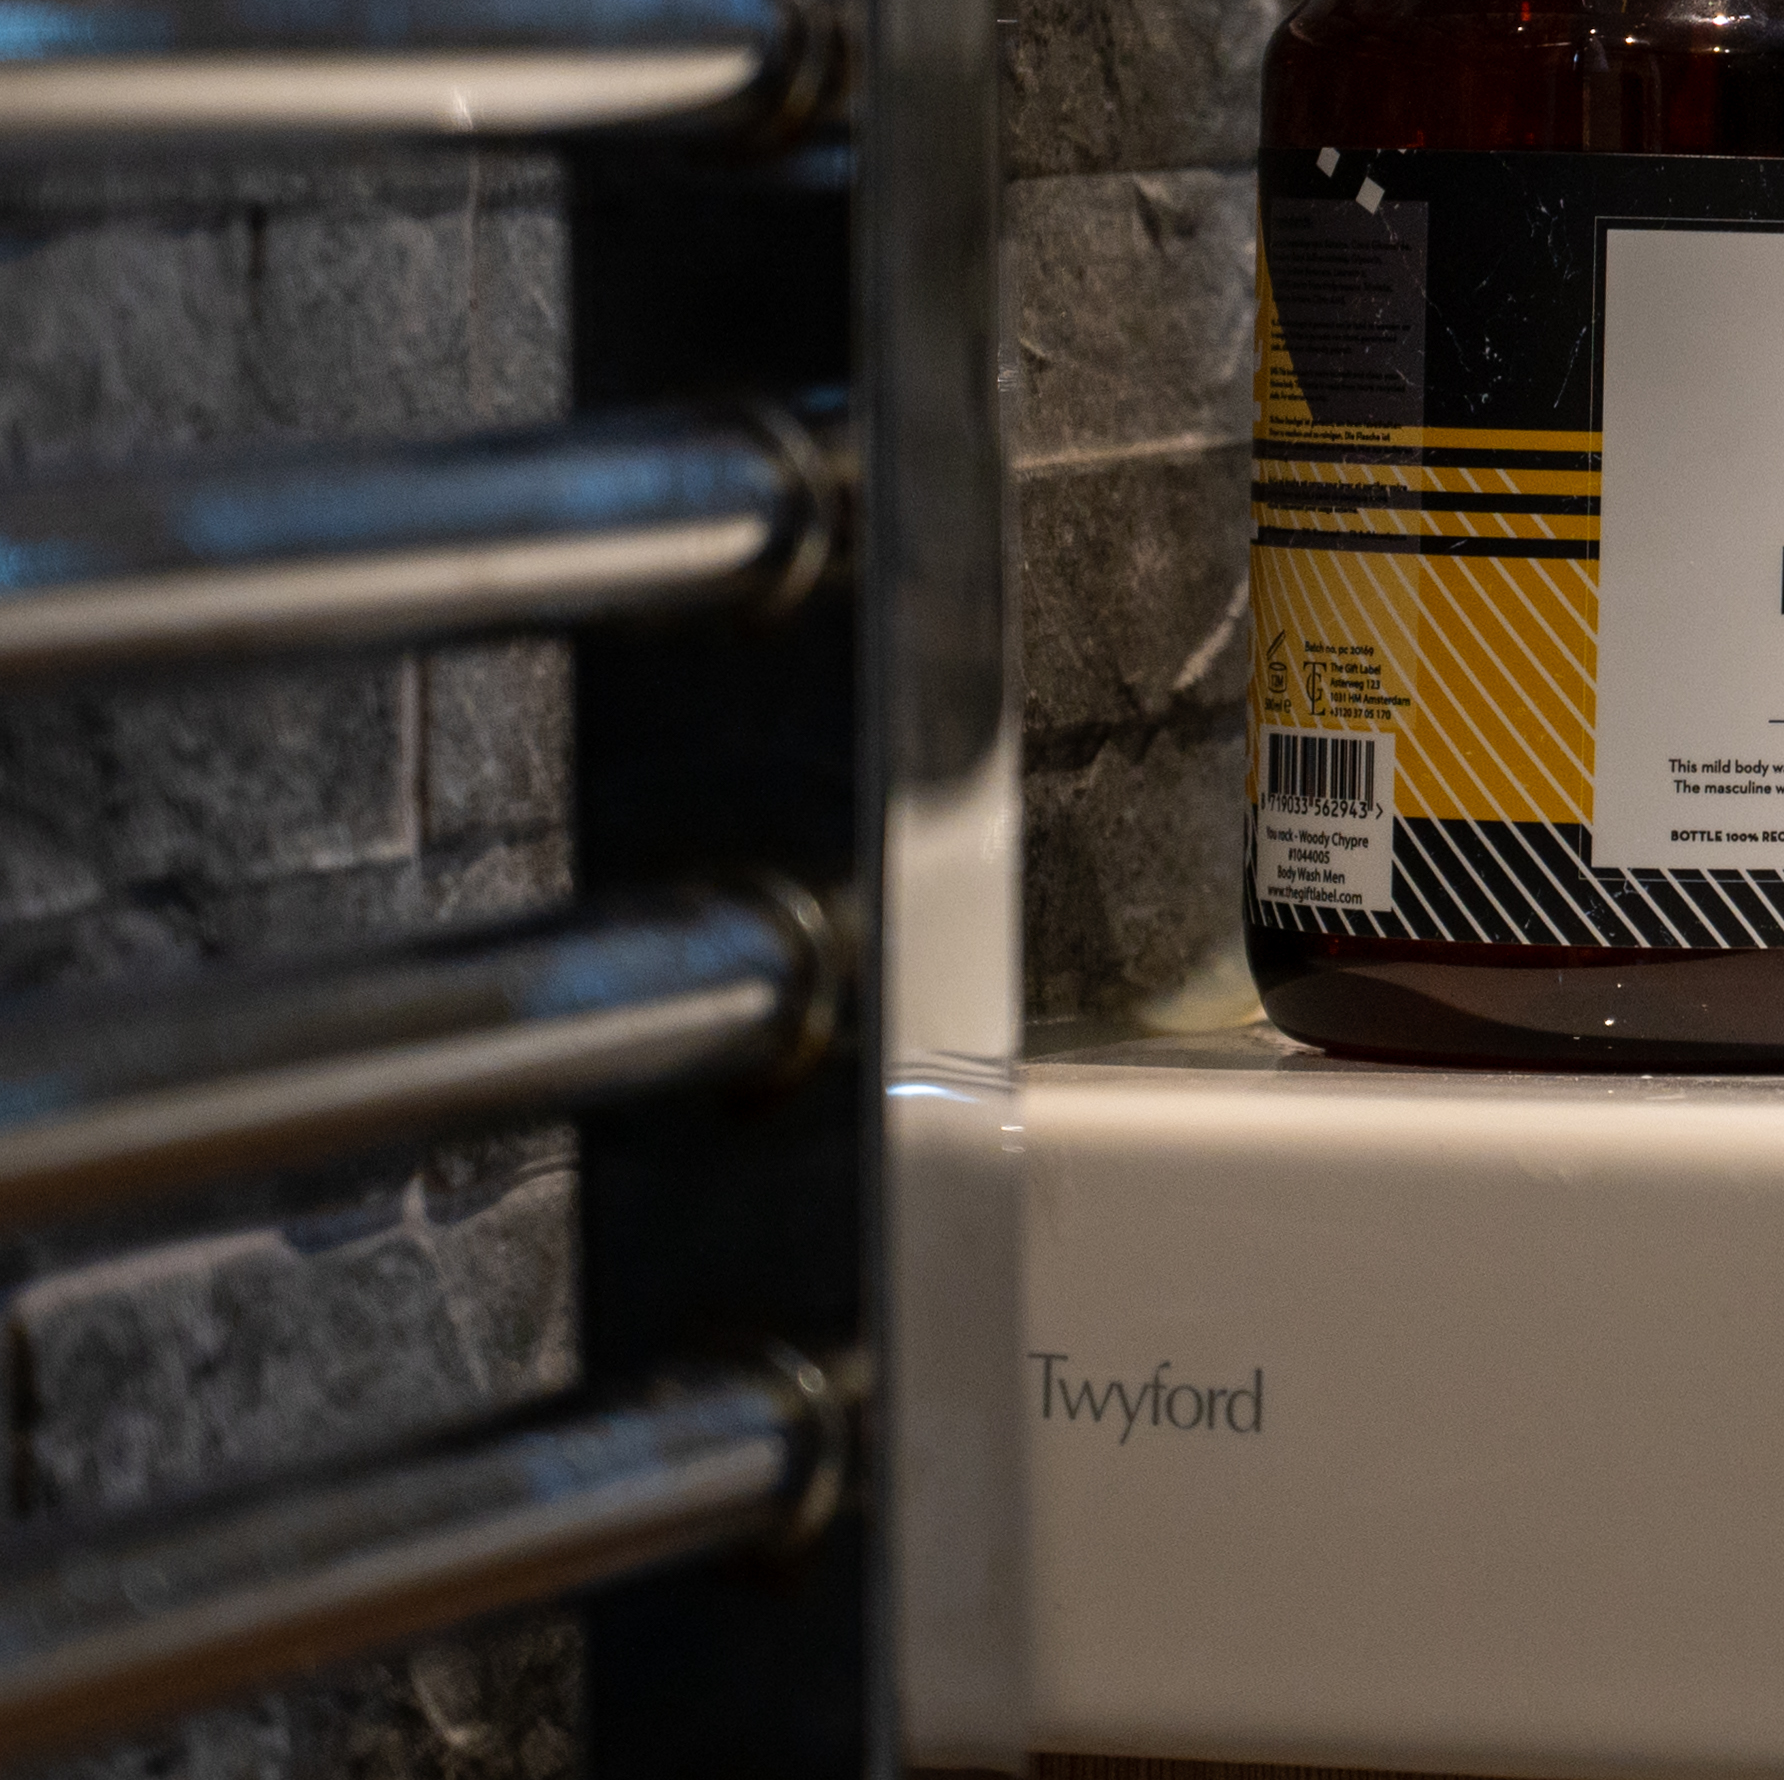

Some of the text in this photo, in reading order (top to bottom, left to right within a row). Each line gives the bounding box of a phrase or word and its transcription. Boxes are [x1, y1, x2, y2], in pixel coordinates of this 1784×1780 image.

[1305, 641, 1324, 653] Batch
[1331, 663, 1381, 675] The Gift Label
[1366, 679, 1380, 690] 123
[1330, 692, 1411, 707] 1031 HM Amsterdam
[1353, 707, 1363, 718] 37
[1376, 709, 1391, 720] 170
[1668, 759, 1698, 774] This
[1701, 759, 1732, 774] mild
[1735, 759, 1769, 777] body
[1673, 779, 1701, 794] The
[1704, 779, 1772, 795] masculine
[1269, 794, 1308, 815] 719033
[1314, 799, 1368, 819] 562943
[1266, 826, 1277, 840] You
[1278, 828, 1293, 842] rock
[1299, 830, 1330, 848] Woody
[1331, 832, 1369, 850] Chypre
[1671, 830, 1723, 842] BOTTLE
[1726, 831, 1759, 843] 100%
[1288, 848, 1331, 864] #1044005
[1277, 865, 1346, 884] Body Wash Men
[1267, 885, 1363, 905] www.thegiftlabel.com
[1027, 1352, 1264, 1445] Twyford
